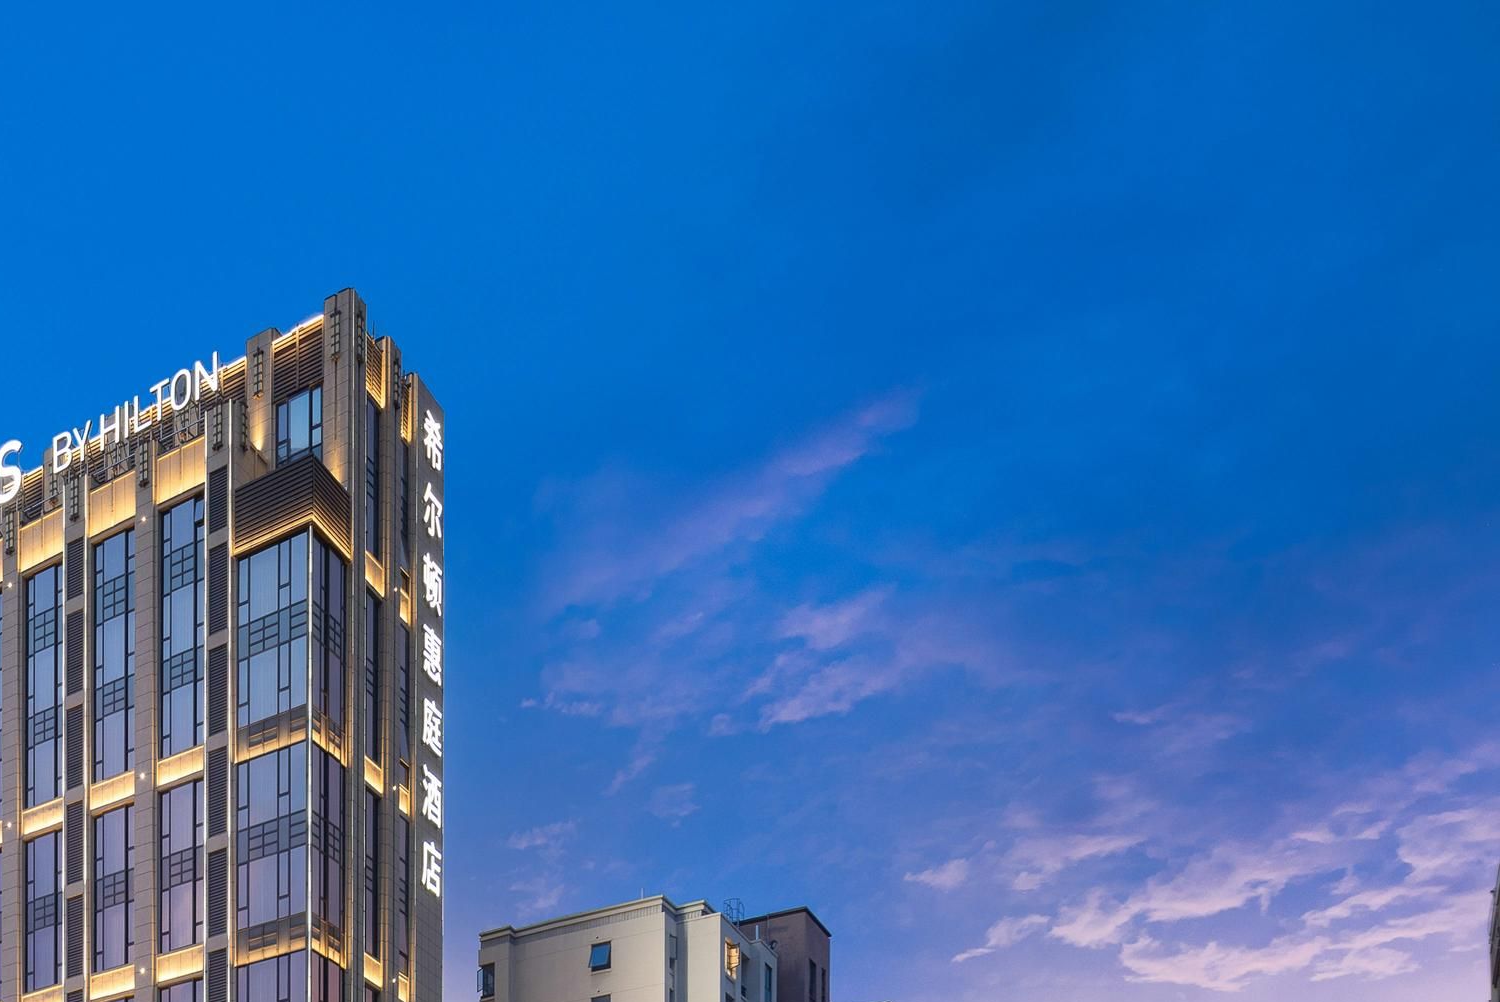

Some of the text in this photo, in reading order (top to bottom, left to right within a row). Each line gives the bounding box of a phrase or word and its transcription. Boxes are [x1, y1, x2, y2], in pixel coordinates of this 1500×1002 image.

[52, 419, 92, 475] BY
[99, 351, 219, 452] HILTON
[422, 409, 444, 898] 希尔顿惠庭酒店
